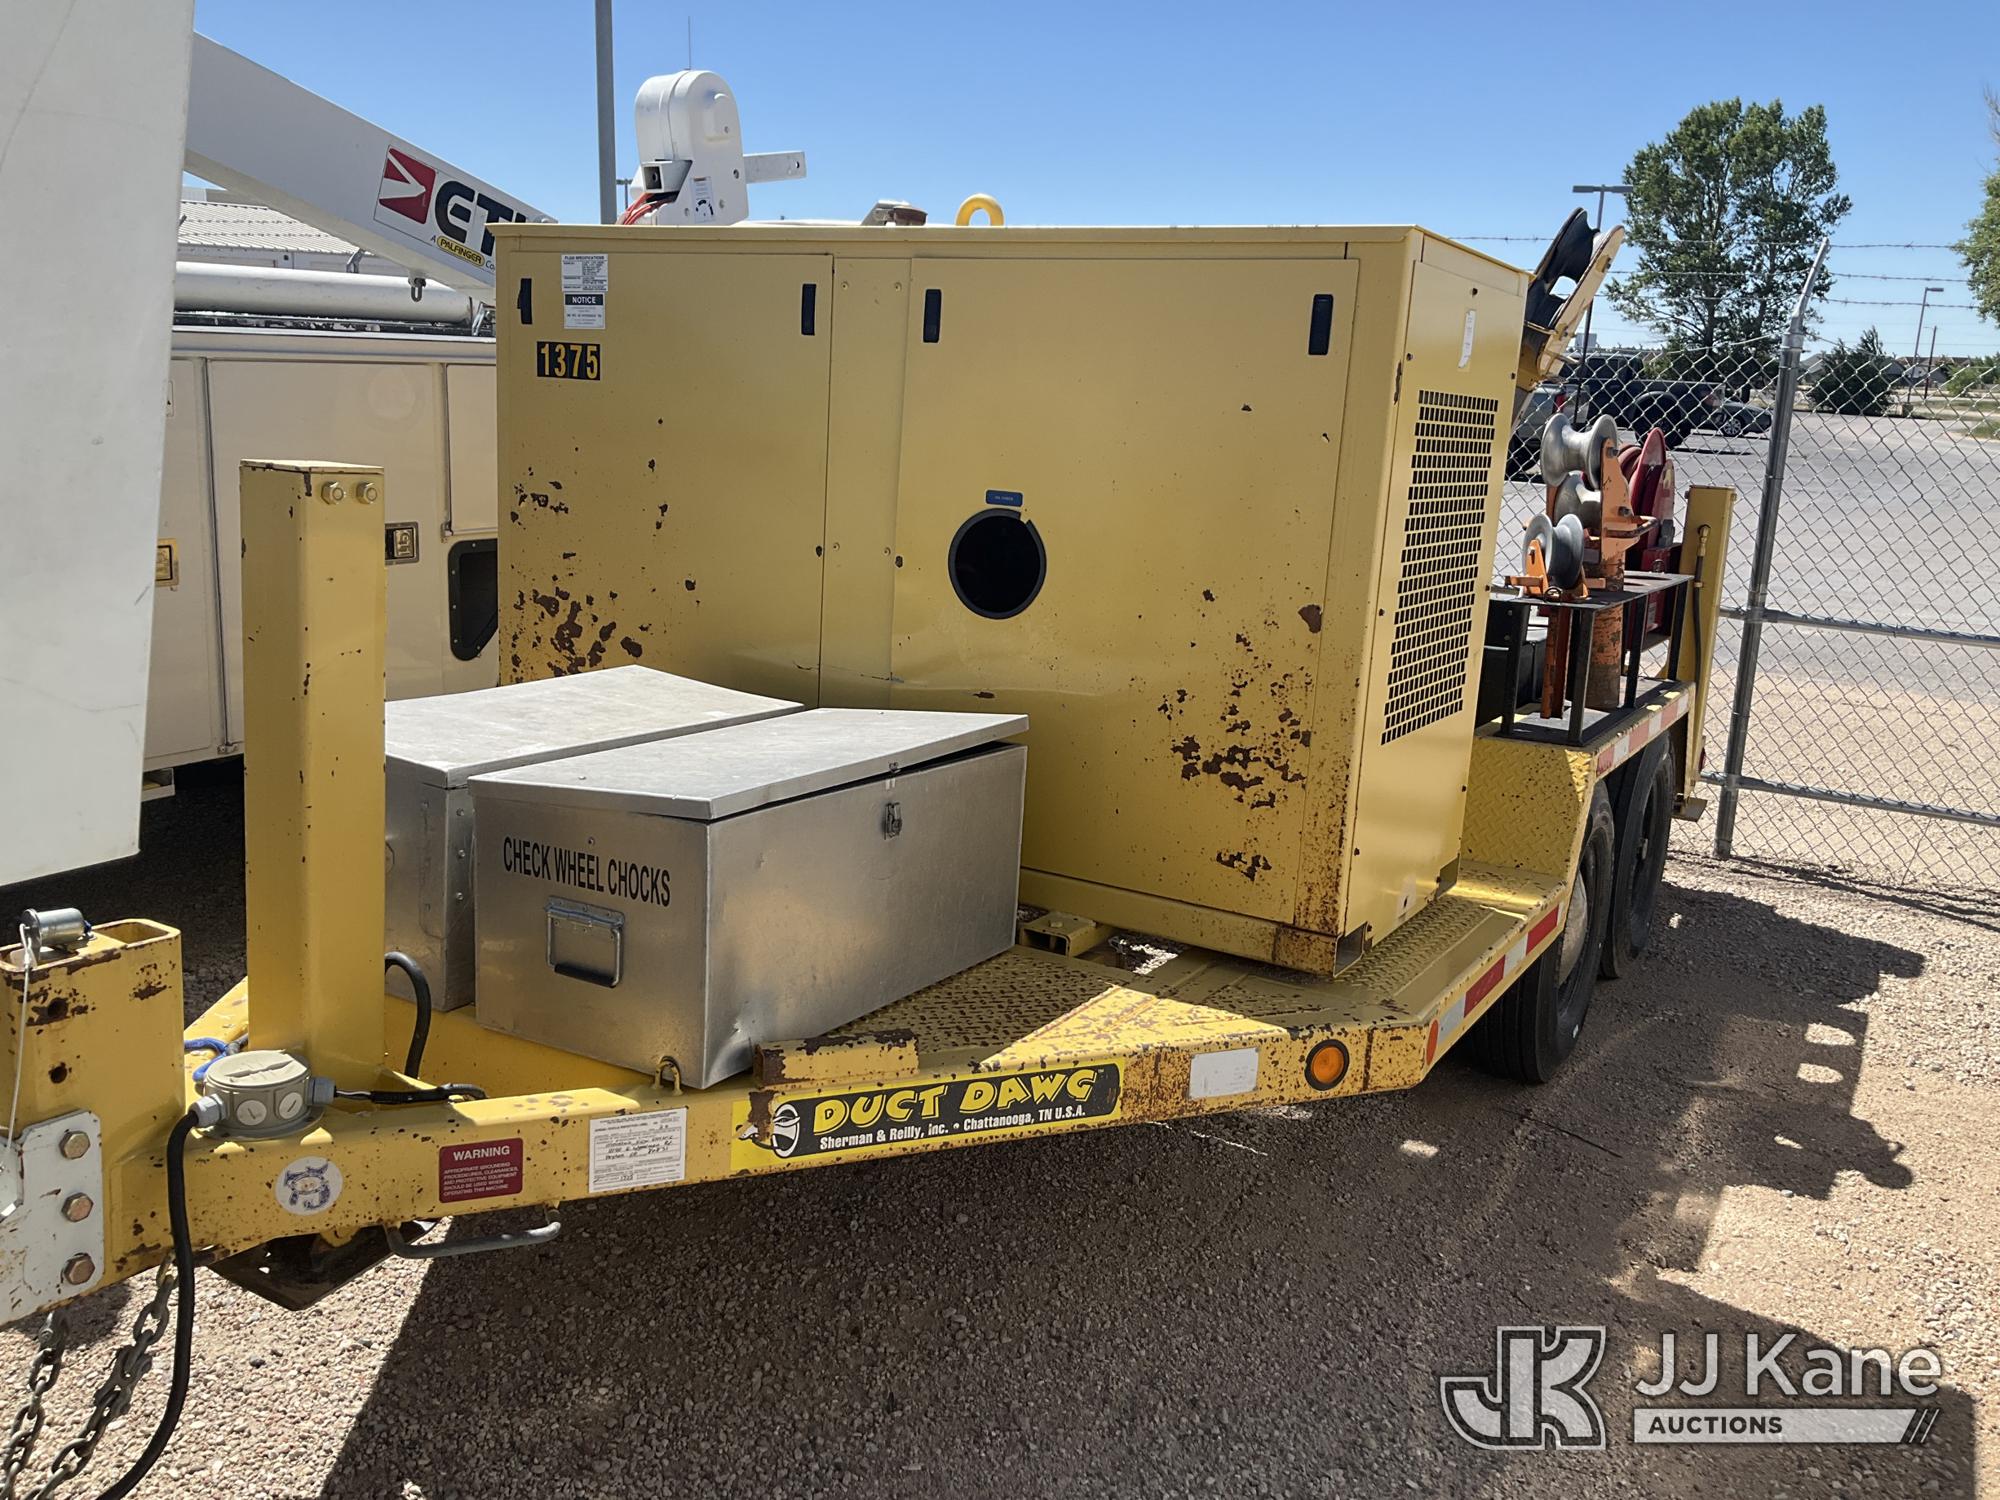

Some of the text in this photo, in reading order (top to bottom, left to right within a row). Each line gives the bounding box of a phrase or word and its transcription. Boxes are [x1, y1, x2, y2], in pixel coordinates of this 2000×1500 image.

[435, 180, 526, 257] ET
[440, 238, 482, 264] PALFINGER
[572, 296, 597, 304] NOTICE
[540, 343, 599, 379] 1375
[503, 836, 671, 907] CHECK WHEEL CHOCKS
[813, 1069, 1098, 1136] DUCT DAWG
[820, 1131, 873, 1150] Sherman
[876, 1129, 886, 1143] &
[889, 1126, 925, 1140] Reilly,
[963, 1112, 1035, 1131] Chattanooga,
[1038, 1109, 1053, 1121] TN
[1055, 1104, 1086, 1119] U.S.A.
[453, 1145, 510, 1161] WARNING
